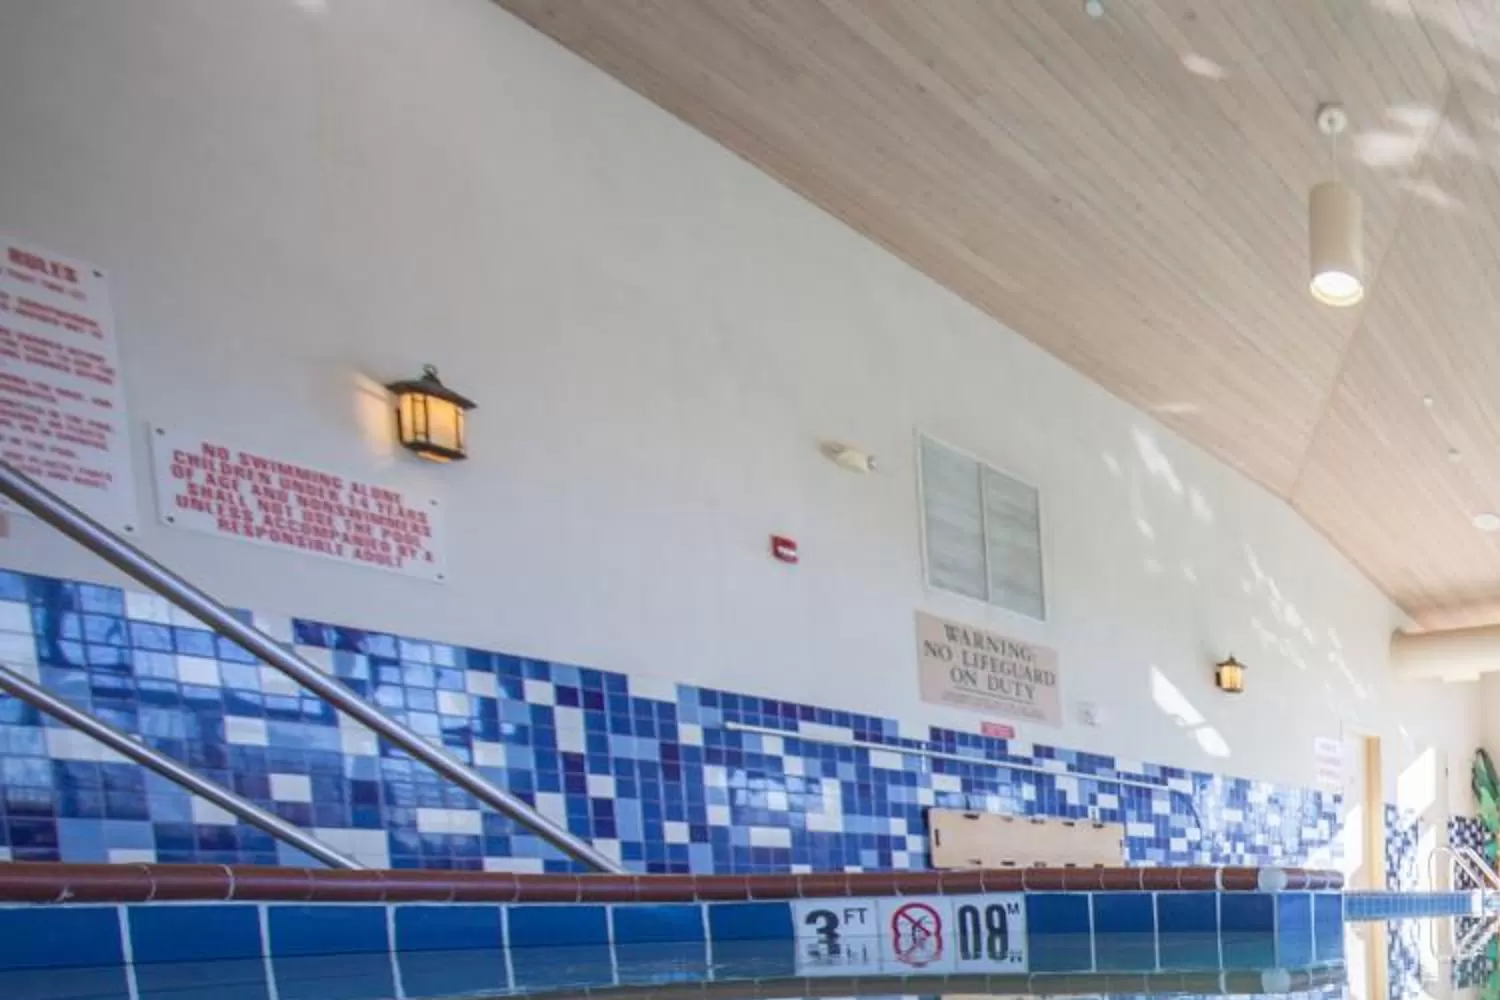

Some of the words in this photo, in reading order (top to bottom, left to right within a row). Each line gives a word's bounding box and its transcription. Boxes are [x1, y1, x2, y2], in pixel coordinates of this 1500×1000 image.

[171, 463, 194, 481] OF
[204, 471, 239, 492] AGE
[251, 483, 288, 504] AND
[172, 448, 272, 486] CHILDREN
[278, 475, 338, 502] UNDER
[375, 499, 427, 524] YEARS
[201, 441, 229, 460] NO
[237, 451, 344, 490] SWIMMING
[175, 493, 253, 523] UNLESS
[187, 481, 247, 507] SHALL
[257, 498, 293, 518] NOT
[343, 518, 372, 536] THE
[216, 517, 344, 556] RESPONSIBLE
[923, 639, 953, 661] NO
[962, 648, 1057, 687] LIFEGUARD
[944, 623, 1032, 662] WARNING
[950, 667, 978, 687] ON
[987, 673, 1036, 700] DUTY
[1006, 902, 1020, 916] M
[805, 909, 841, 962] 3
[843, 907, 868, 925] FT
